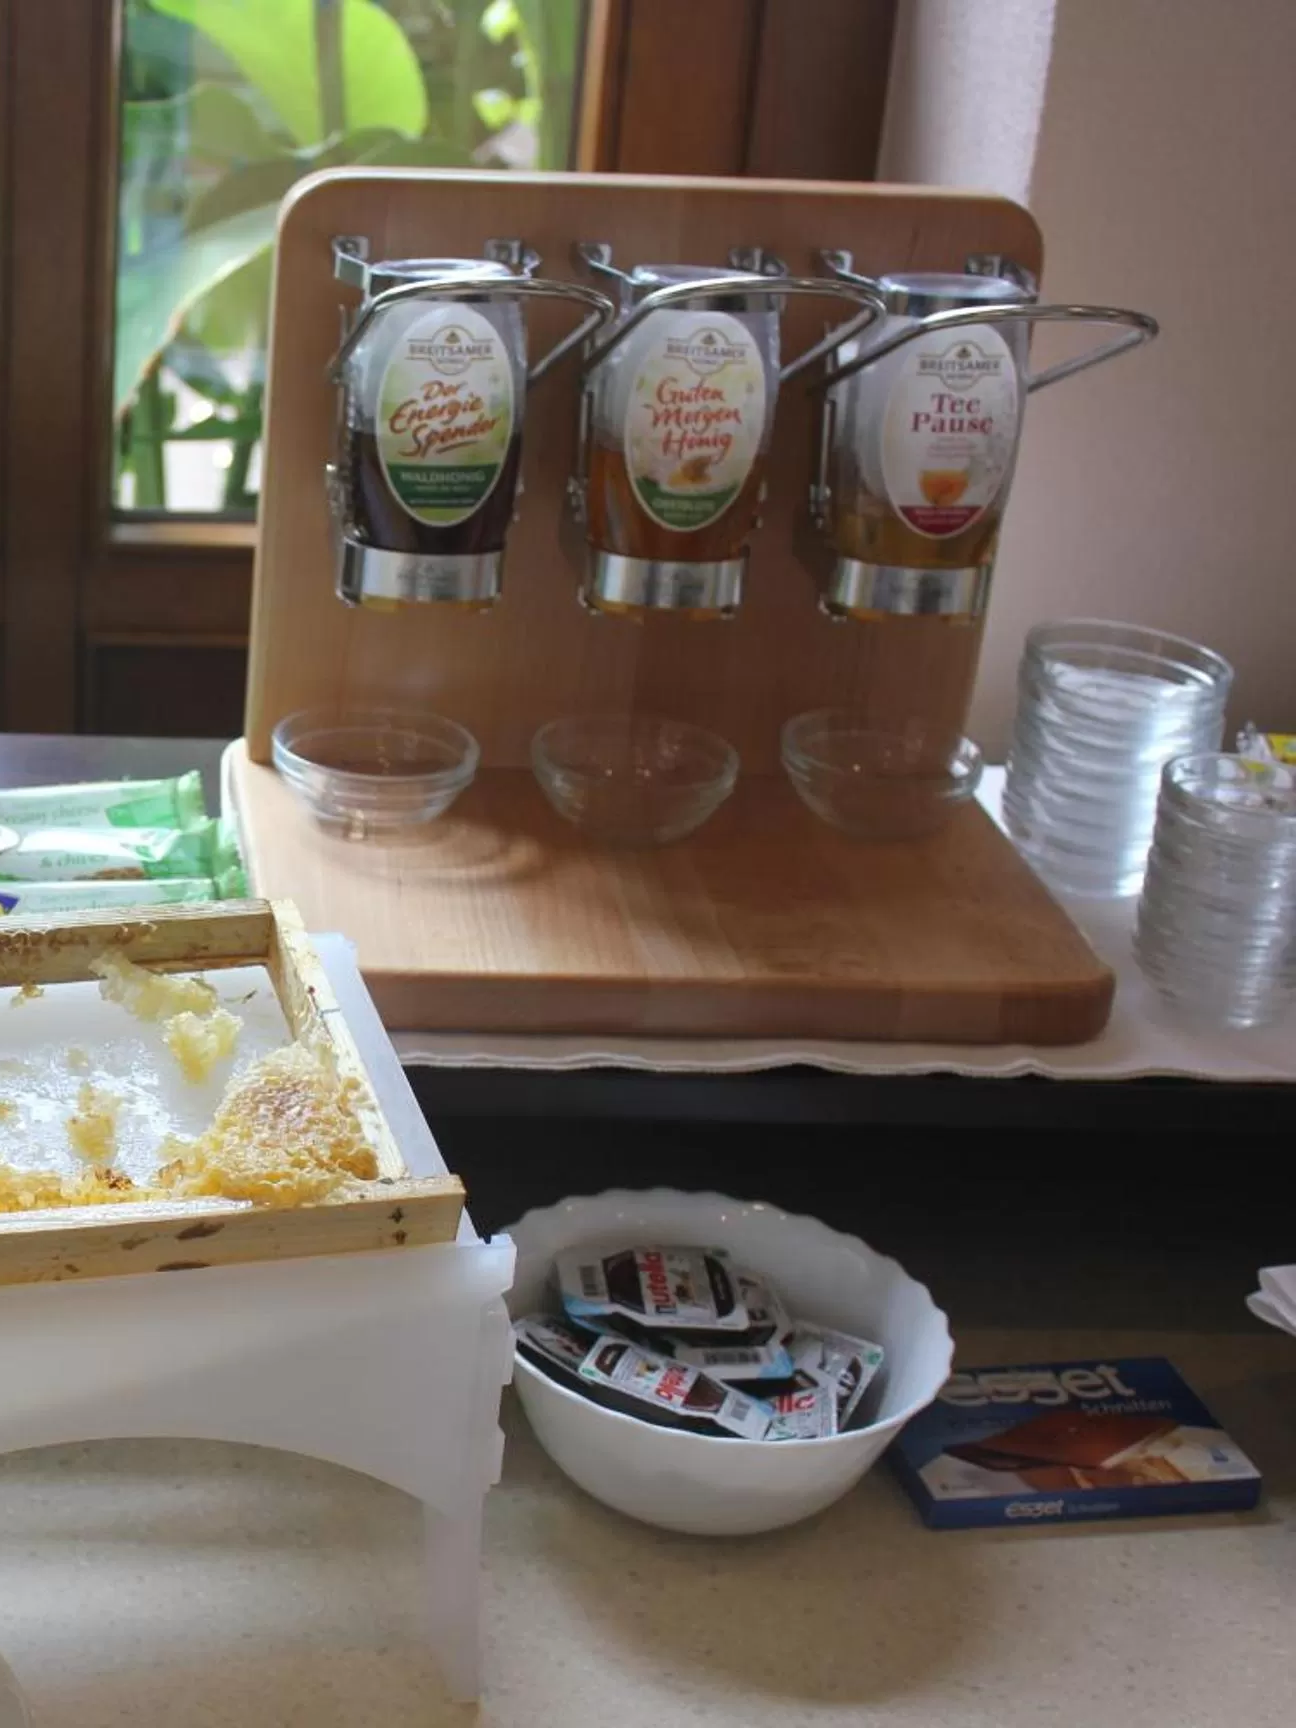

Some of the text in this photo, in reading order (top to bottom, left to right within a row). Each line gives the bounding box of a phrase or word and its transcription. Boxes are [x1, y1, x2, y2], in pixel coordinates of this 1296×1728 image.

[656, 376, 725, 404] Guten
[931, 393, 981, 414] Tee
[641, 404, 743, 434] Morgen
[911, 411, 994, 435] Pause
[662, 428, 733, 463] Honig
